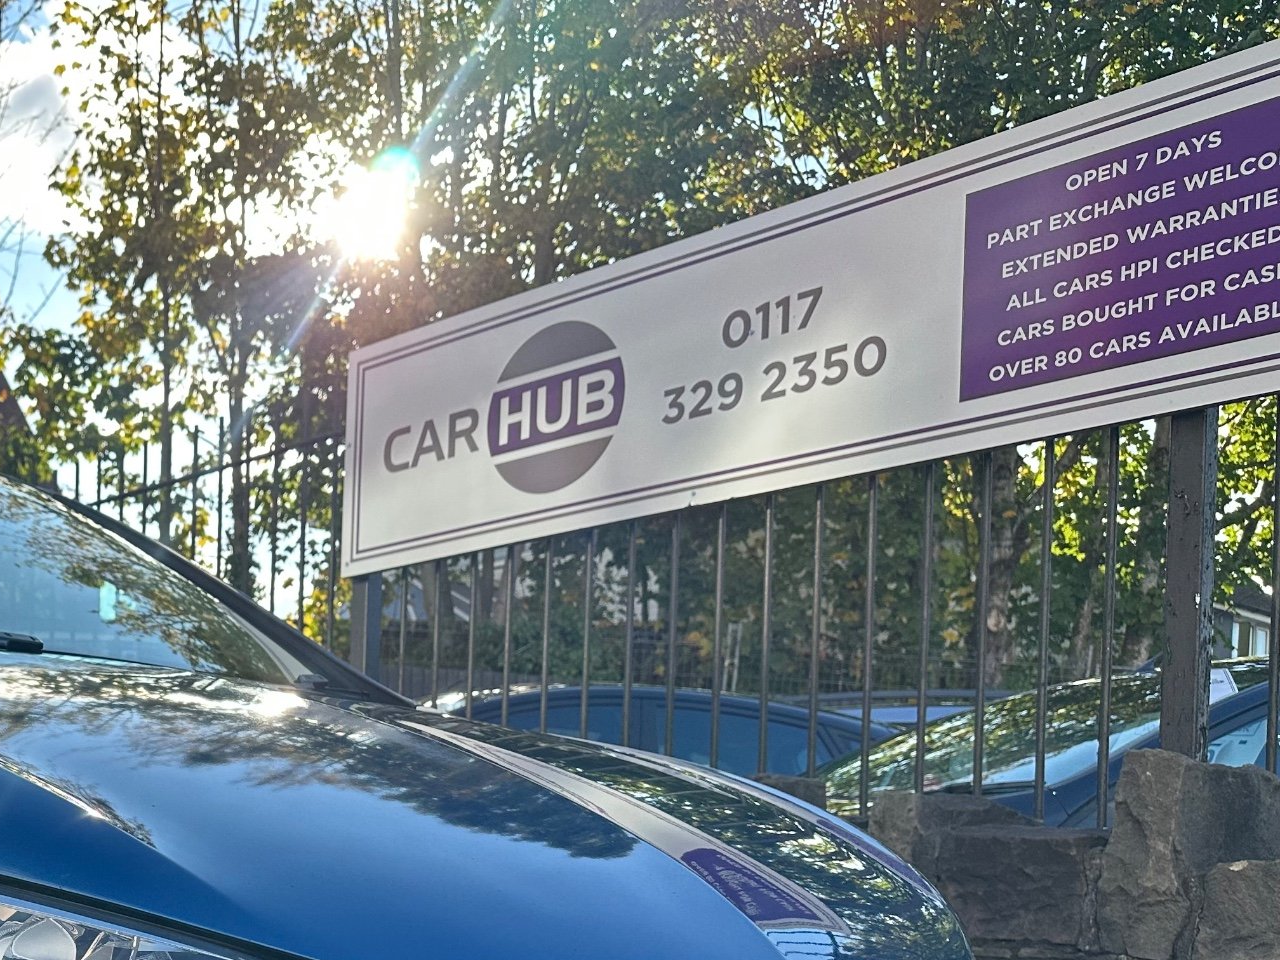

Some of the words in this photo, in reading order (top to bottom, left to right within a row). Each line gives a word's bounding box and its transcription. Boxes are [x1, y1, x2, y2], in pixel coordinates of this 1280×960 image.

[987, 219, 1043, 249] PART
[1049, 181, 1176, 232] EXCHANGE
[1183, 149, 1280, 192] WELCO
[1065, 159, 1128, 191] OPEN
[1135, 152, 1149, 171] 7
[1156, 130, 1222, 165] DAYS
[1001, 233, 1119, 278] EXTENDED
[1126, 187, 1280, 243] WARRANTIE
[1006, 289, 1047, 311] ALL
[1053, 270, 1113, 298] CARS
[1120, 257, 1159, 282] HPI
[1165, 225, 1280, 269] CHECKED
[722, 286, 823, 348] 0117
[997, 319, 1055, 346] CARS
[1061, 293, 1159, 332] BOUGHT
[1165, 280, 1216, 307] FOR
[1223, 262, 1280, 291] CAS
[662, 372, 743, 425] 329
[760, 335, 888, 403] 2350
[988, 355, 1048, 382] OVER
[1054, 347, 1082, 368] 80
[1089, 331, 1151, 359] CARS
[383, 407, 480, 474] CAR
[497, 368, 615, 447] HUB
